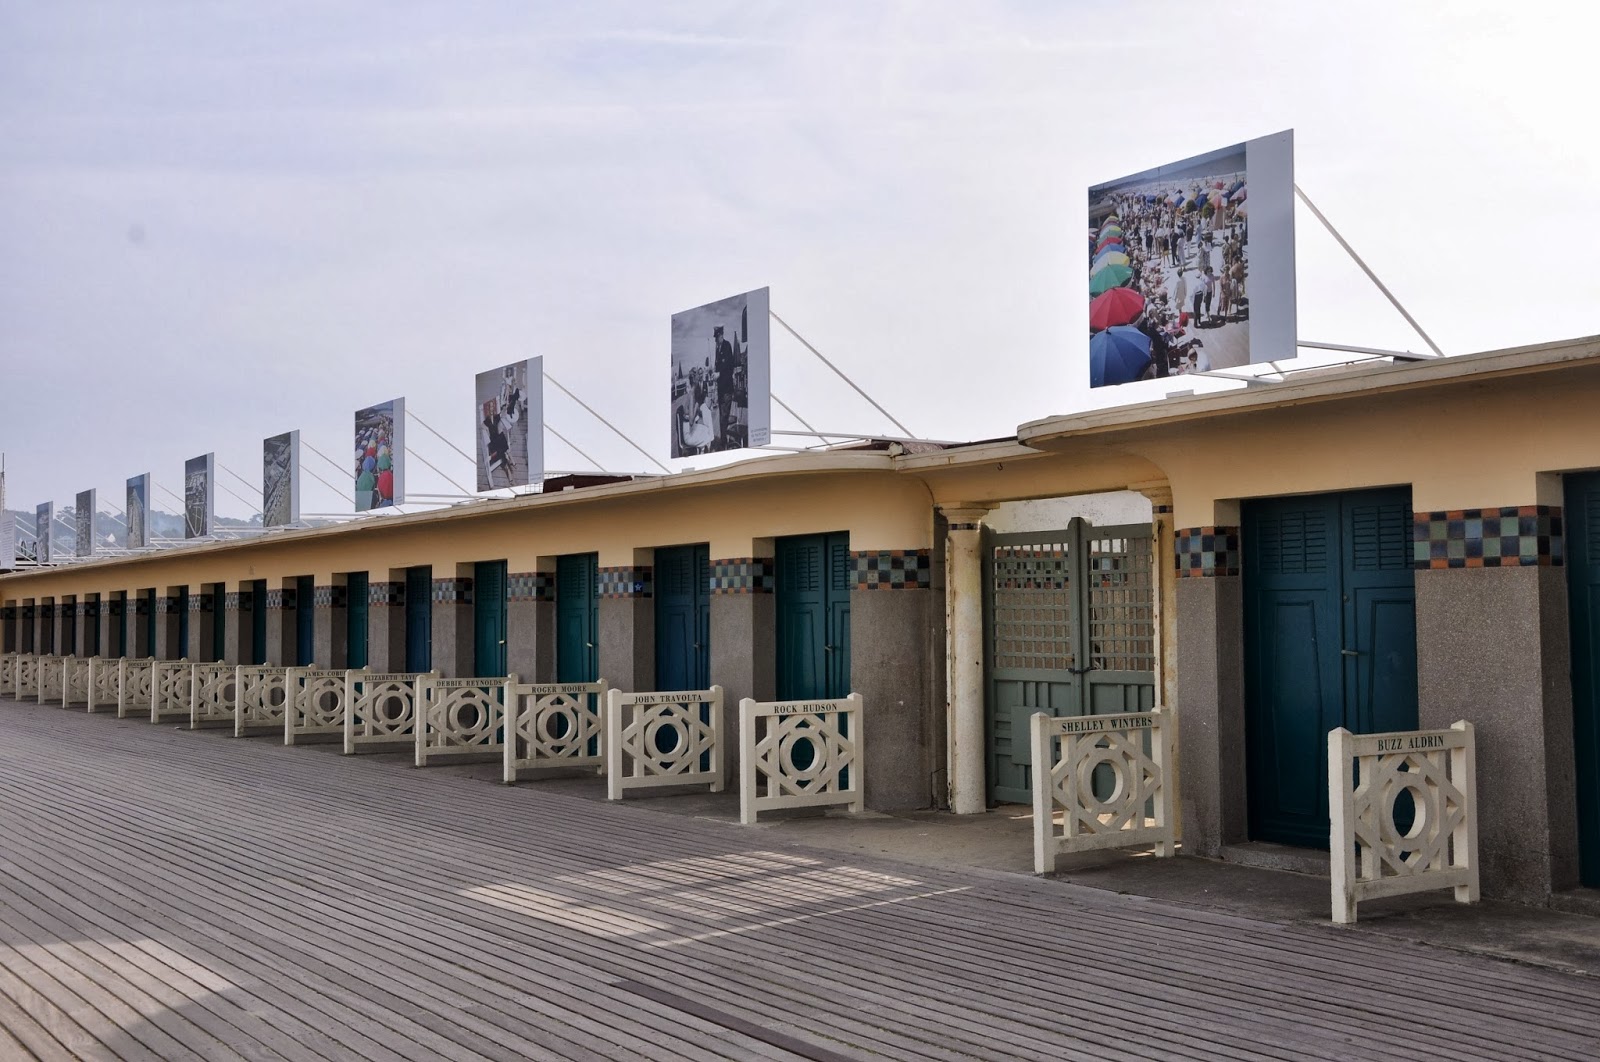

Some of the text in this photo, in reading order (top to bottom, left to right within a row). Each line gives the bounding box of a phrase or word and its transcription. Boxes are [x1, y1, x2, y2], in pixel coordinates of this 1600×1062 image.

[634, 694, 702, 704] JOHN TRAVOLTA
[774, 703, 837, 714] ROCK HUDSON
[1062, 717, 1153, 732] SHELLEY WINTERS
[1378, 735, 1444, 751] BUZZ ALDRIN
